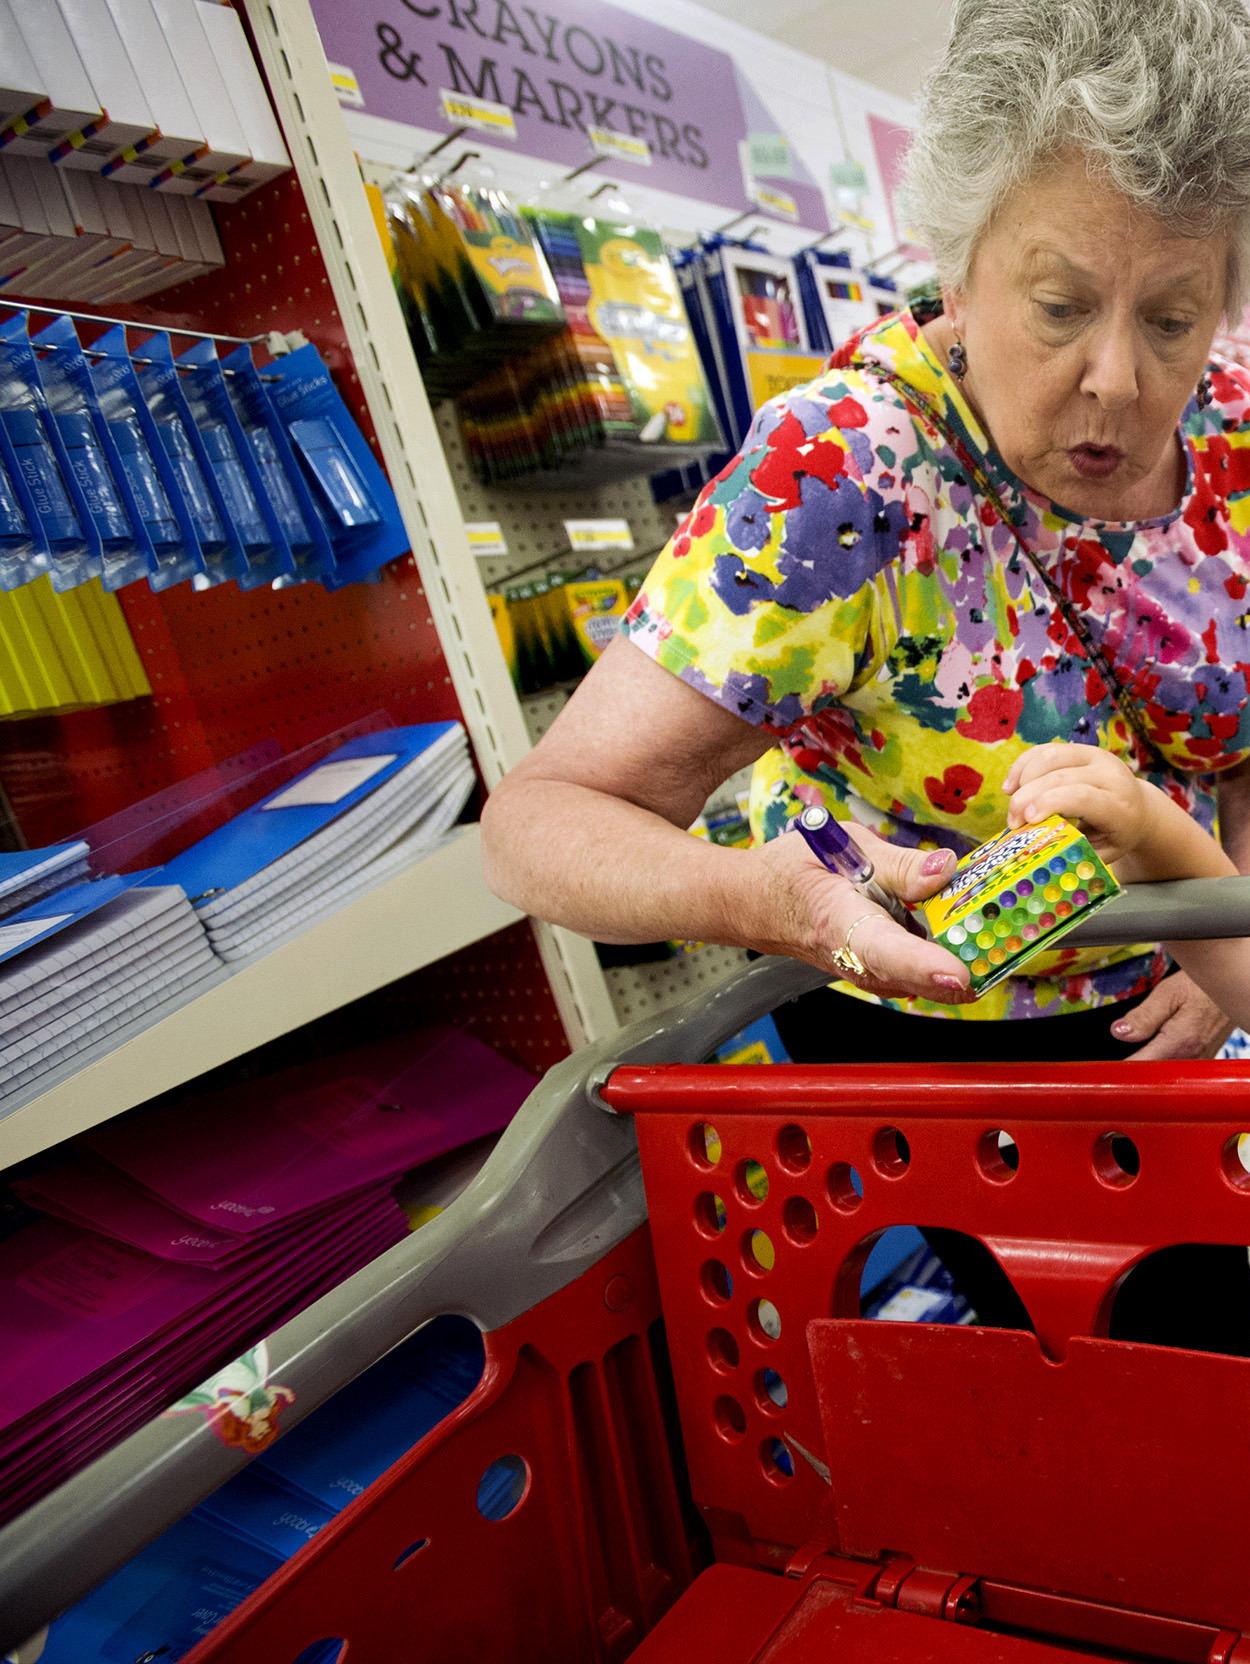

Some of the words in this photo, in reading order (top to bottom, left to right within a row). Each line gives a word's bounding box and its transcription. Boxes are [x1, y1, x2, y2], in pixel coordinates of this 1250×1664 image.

[375, 22, 428, 86] &
[438, 42, 710, 170] MARKERS
[21, 458, 42, 488] Stick
[72, 460, 94, 488] Stick
[36, 486, 52, 515] Glue
[83, 486, 104, 515] Glue
[953, 842, 1059, 915] Crayola
